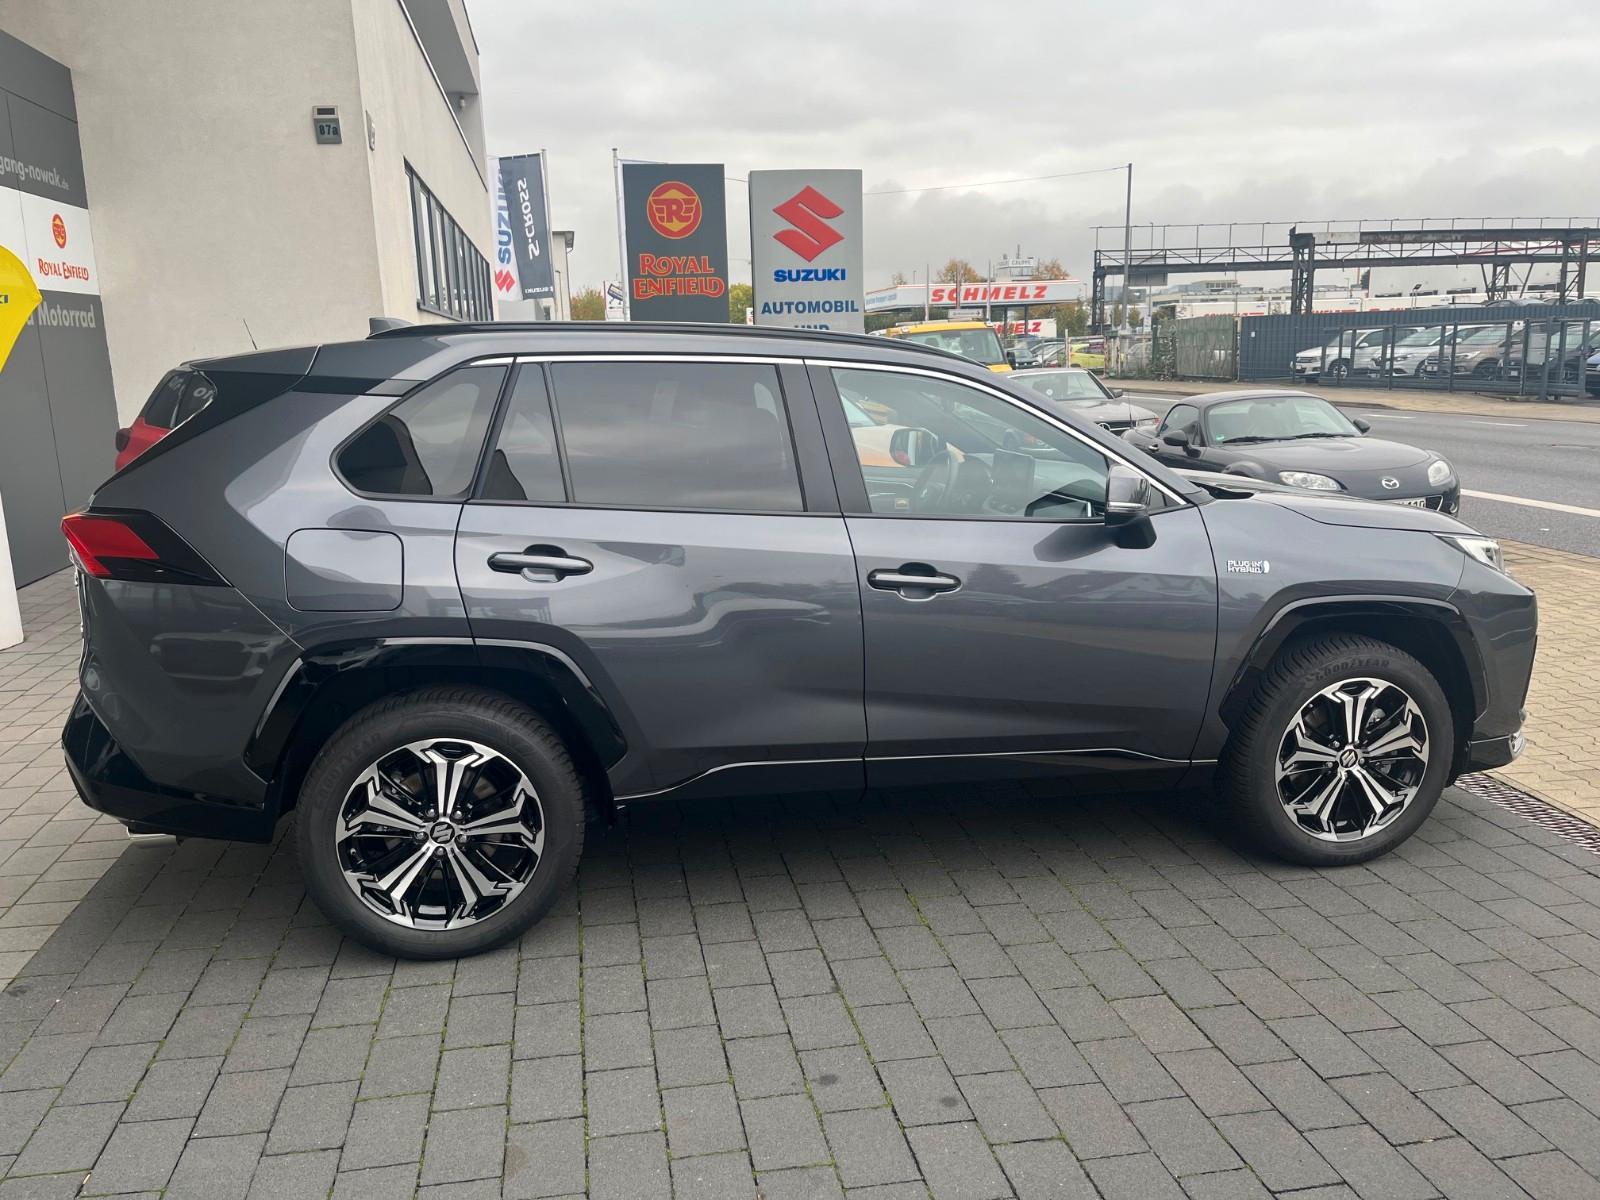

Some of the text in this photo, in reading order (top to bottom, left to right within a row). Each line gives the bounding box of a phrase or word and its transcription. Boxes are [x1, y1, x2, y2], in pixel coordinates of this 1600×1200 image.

[318, 124, 339, 136] 87a
[38, 257, 89, 281] ROYAL ENFIELD
[639, 253, 715, 277] ROYAL
[773, 268, 846, 283] SUZUKI
[633, 276, 725, 300] ENFIELD
[930, 285, 1048, 303] SCHMELZ
[38, 301, 96, 328] Motorrad
[761, 300, 859, 315] AUTOMOBIL
